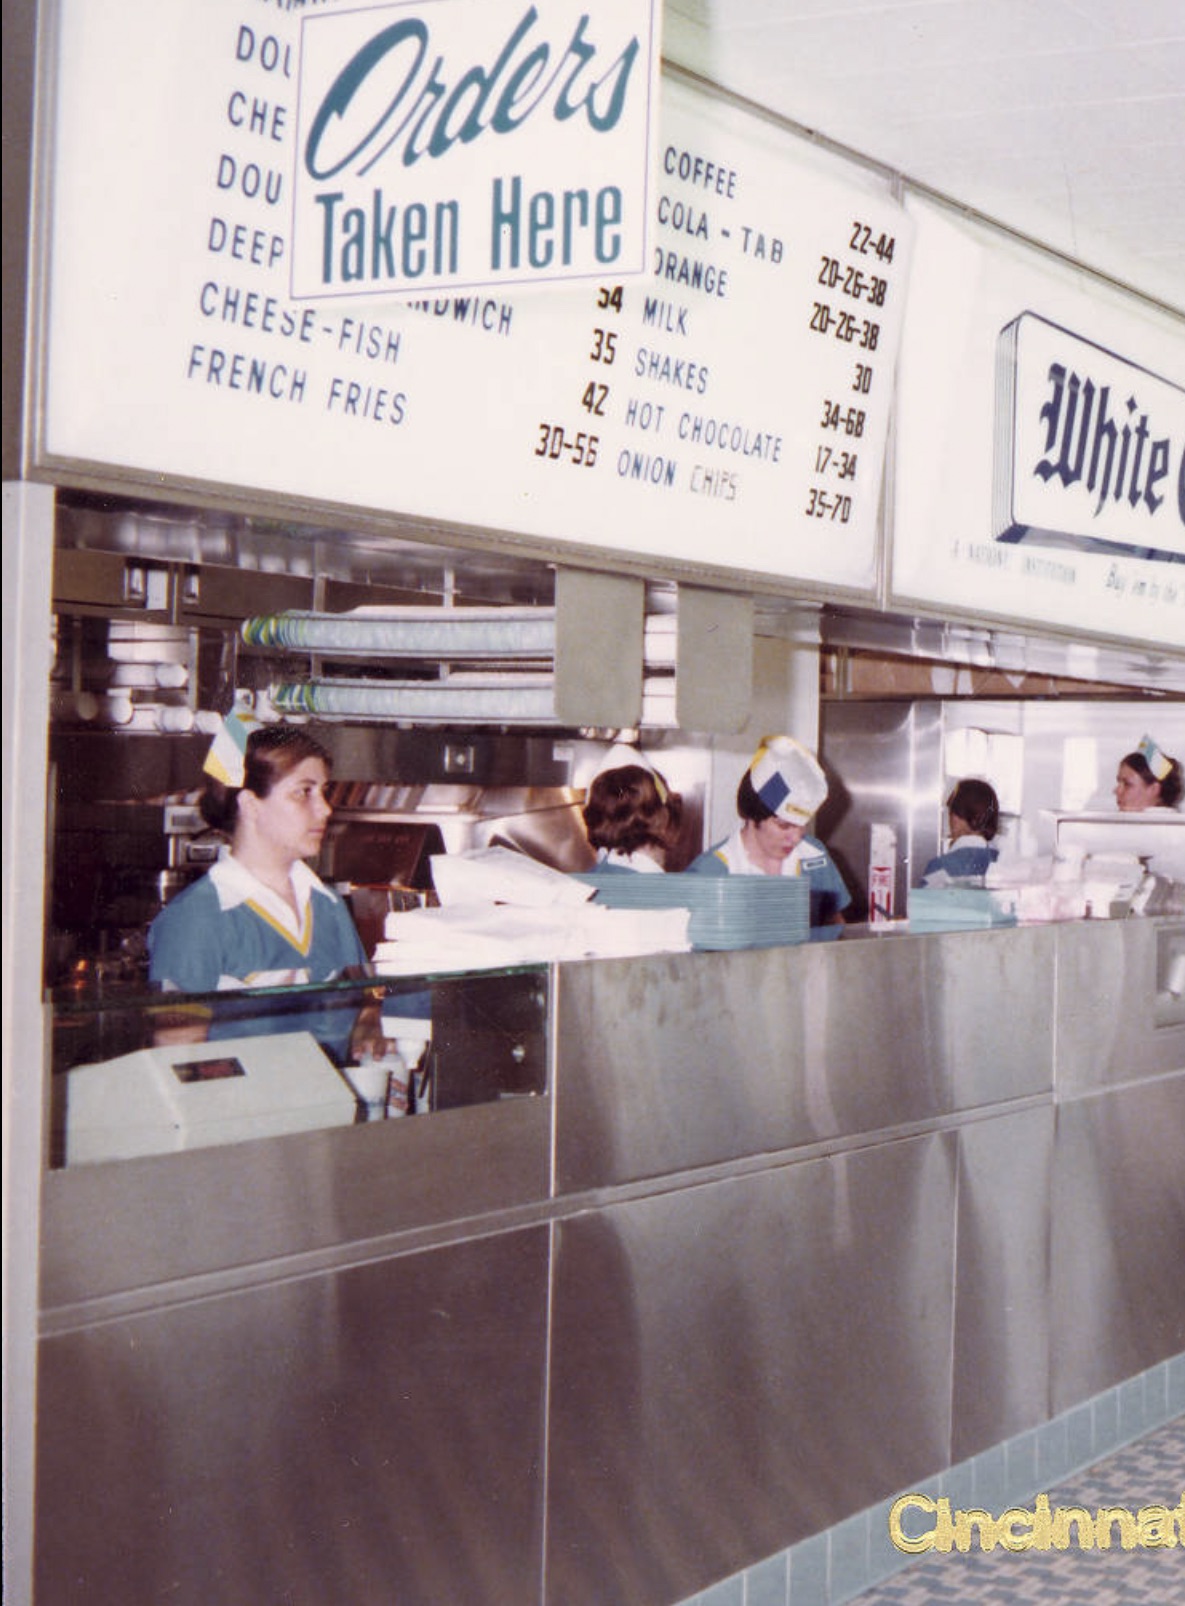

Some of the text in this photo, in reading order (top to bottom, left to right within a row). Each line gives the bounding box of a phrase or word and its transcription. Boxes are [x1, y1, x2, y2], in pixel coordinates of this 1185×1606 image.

[228, 91, 287, 141] CHE
[305, 5, 640, 181] Orders
[217, 154, 282, 204] DOU
[664, 146, 737, 199] COFFEE
[208, 217, 284, 268] DEEP
[314, 175, 622, 284] Taken Here
[657, 195, 708, 240] COLA
[741, 226, 783, 264] TAB
[849, 221, 895, 265] 22-44
[818, 256, 887, 308] 20-26-38
[199, 281, 400, 364] CHEESE-FISH
[643, 296, 688, 336] MILK
[809, 302, 880, 351] 20-26-38
[590, 328, 617, 365] 35
[187, 344, 407, 425] FRENCH FRIES
[634, 348, 709, 395] SHAKES
[852, 363, 872, 394] 30
[582, 381, 609, 416] 42
[820, 399, 866, 438] 34-68
[535, 423, 600, 468] 30-56
[625, 399, 783, 463] HOT CHOCOLATE
[1033, 362, 1170, 519] White
[617, 449, 677, 486] ONION
[815, 445, 858, 481] 17-34
[805, 487, 852, 524] 35-70
